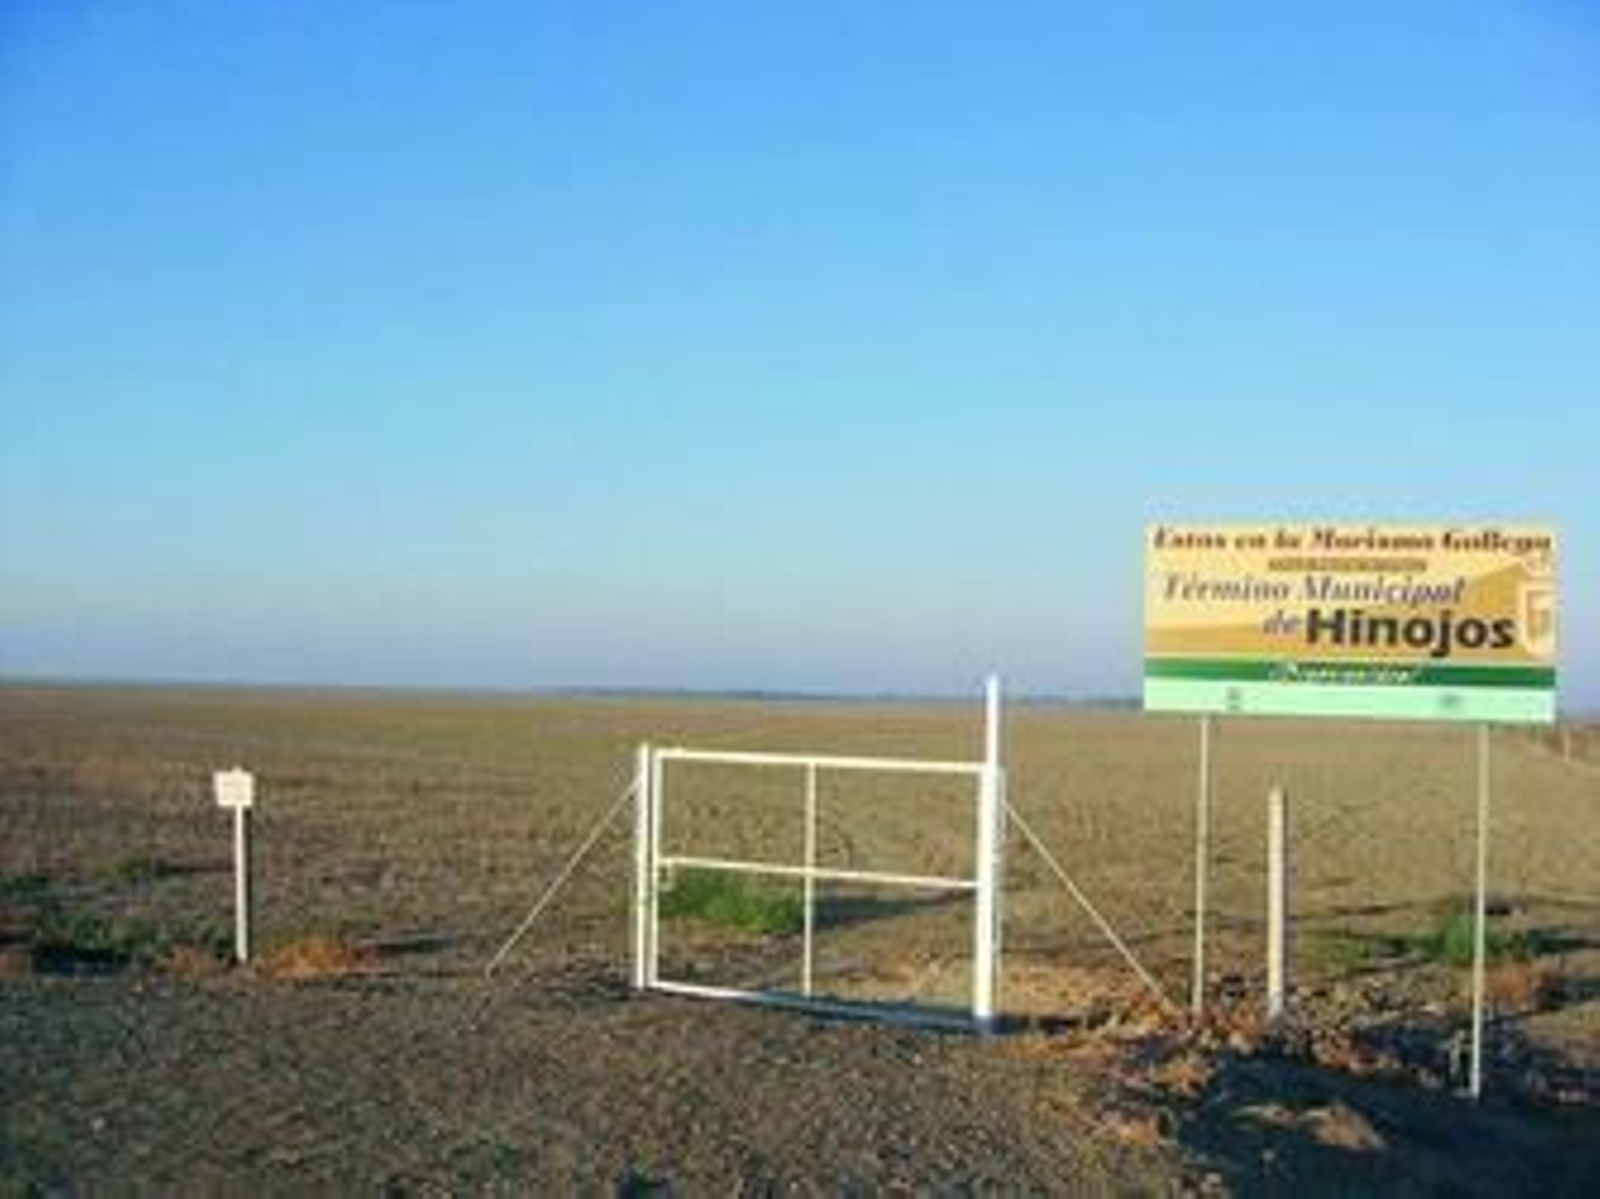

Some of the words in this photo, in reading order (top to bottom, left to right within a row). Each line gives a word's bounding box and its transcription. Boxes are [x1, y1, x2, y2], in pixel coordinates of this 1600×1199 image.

[1301, 575, 1466, 607] Municipal
[1263, 611, 1300, 634] de
[1305, 608, 1515, 657] Hinojos
